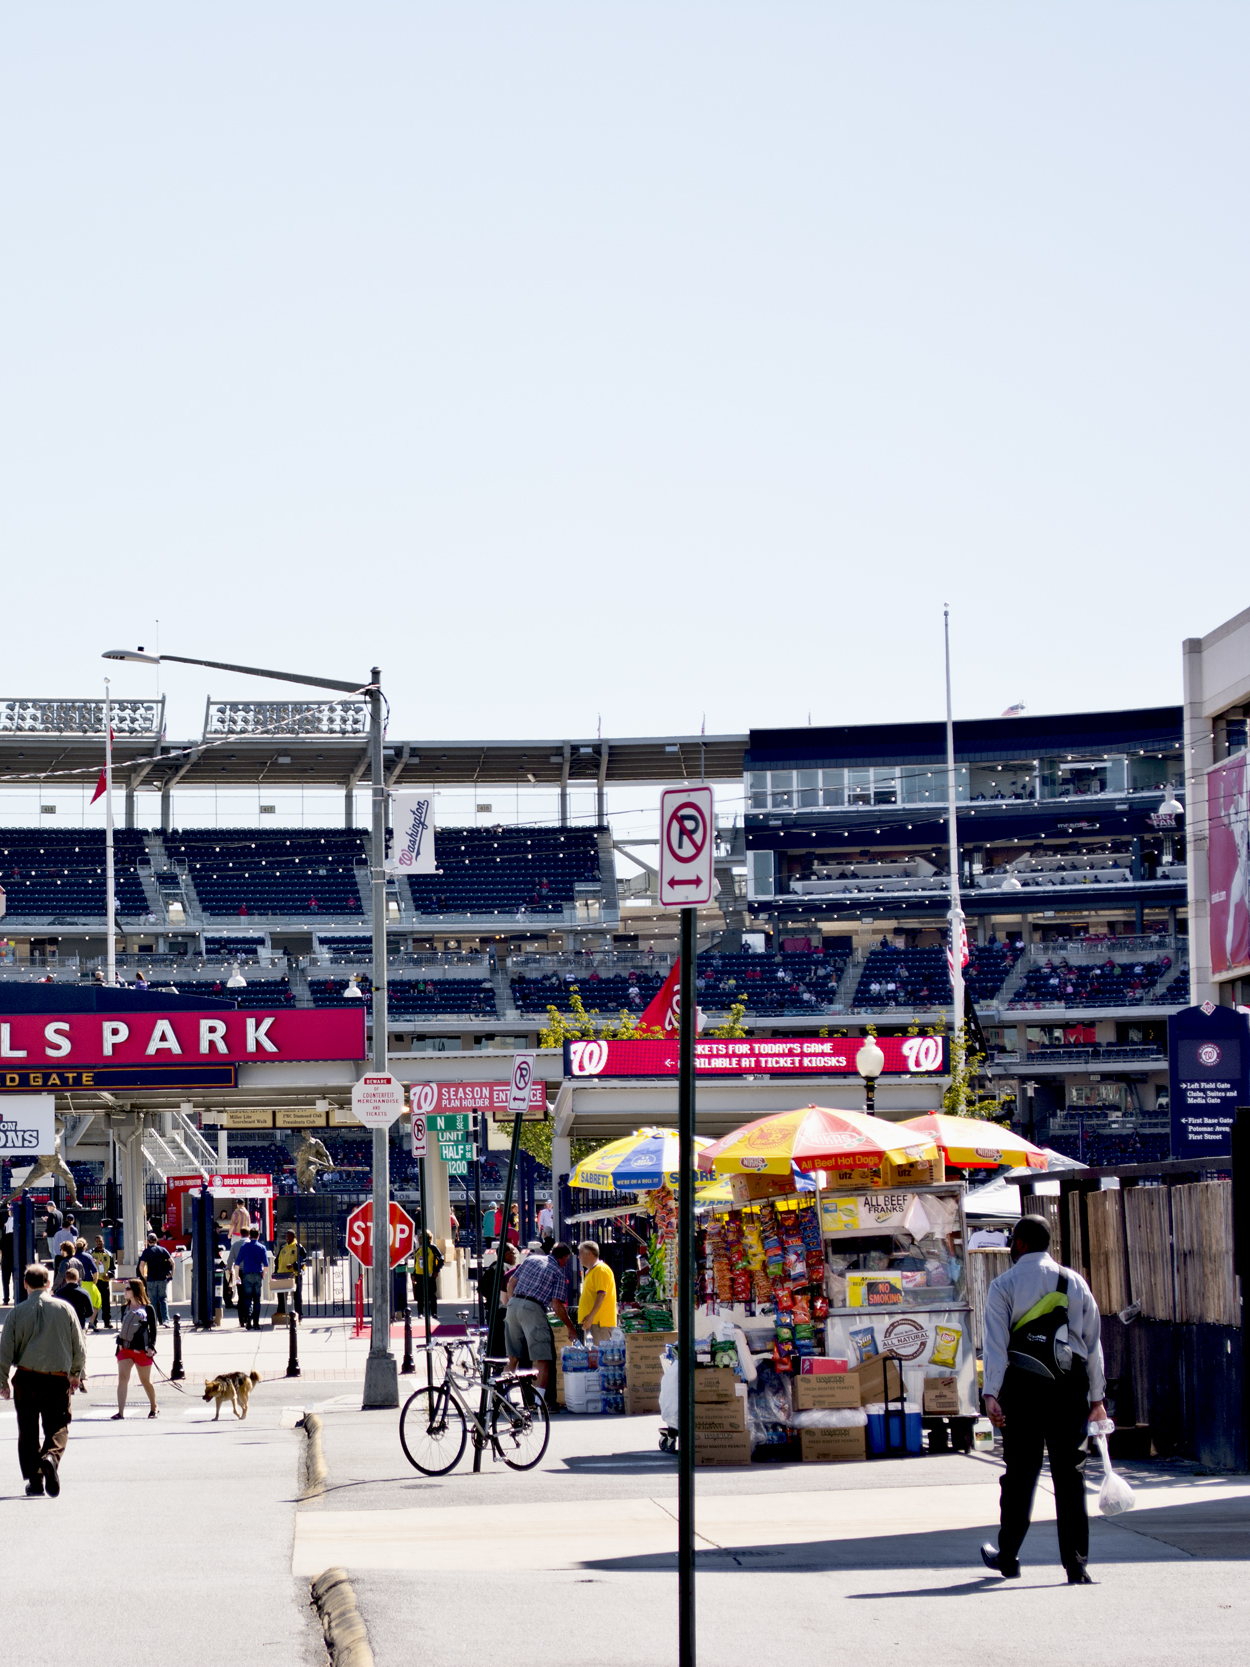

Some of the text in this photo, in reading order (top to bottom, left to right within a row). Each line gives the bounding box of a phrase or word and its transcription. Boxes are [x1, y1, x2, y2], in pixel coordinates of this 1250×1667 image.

[1153, 819, 1176, 827] FAN
[399, 800, 429, 866] Washington
[101, 1016, 280, 1057] PARK
[728, 1043, 834, 1054] FOR TODAY'S GAME
[741, 1056, 846, 1068] AT TICKET KIOSKS
[28, 1072, 95, 1087] GATE
[442, 1087, 490, 1099] SEASON
[442, 1099, 490, 1108] PLAN HOLDER
[437, 1116, 445, 1130] N
[439, 1132, 464, 1142] UNIT
[442, 1145, 464, 1159] HALF
[449, 1161, 467, 1174] 1200
[801, 1156, 879, 1170] All Beef Hot Dogs
[580, 1171, 610, 1187] SABRETT
[864, 1194, 908, 1208] ALL BEEF
[868, 1206, 904, 1214] FRANKS
[351, 1221, 410, 1248] STP
[878, 1283, 890, 1294] NO
[868, 1292, 902, 1304] SMOKING
[857, 1334, 872, 1346] Sun
[898, 1332, 929, 1344] NATURAL
